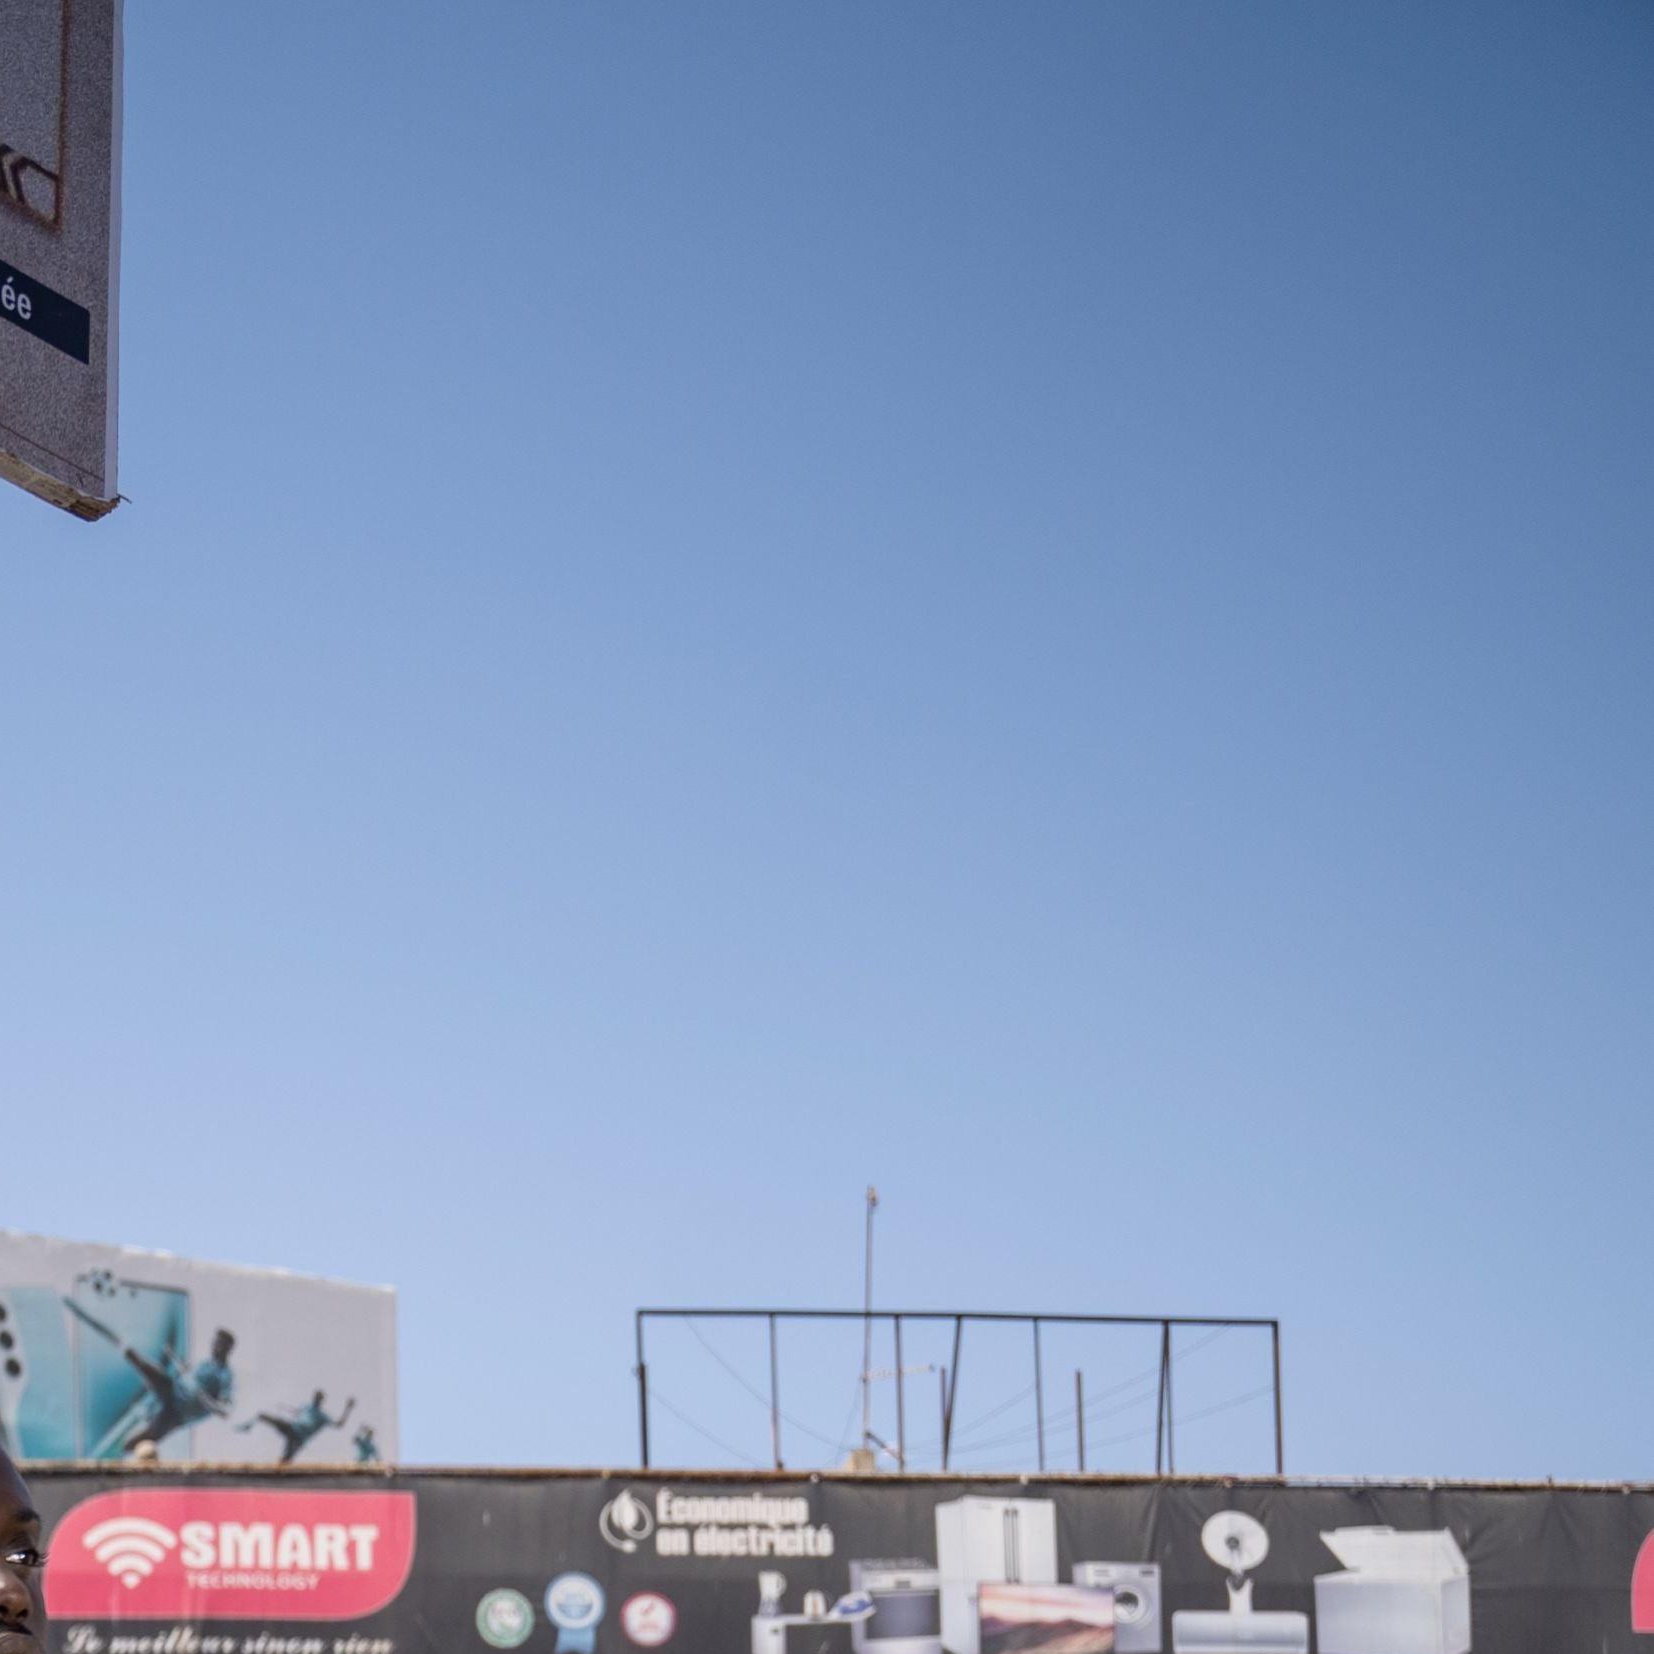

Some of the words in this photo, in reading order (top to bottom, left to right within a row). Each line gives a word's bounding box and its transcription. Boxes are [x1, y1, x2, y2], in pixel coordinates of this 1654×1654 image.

[656, 1487, 809, 1527] Économique
[180, 1520, 380, 1571] SMART
[656, 1529, 689, 1556] en
[694, 1524, 834, 1557] électricité
[187, 1572, 320, 1590] TECHNOLOGY
